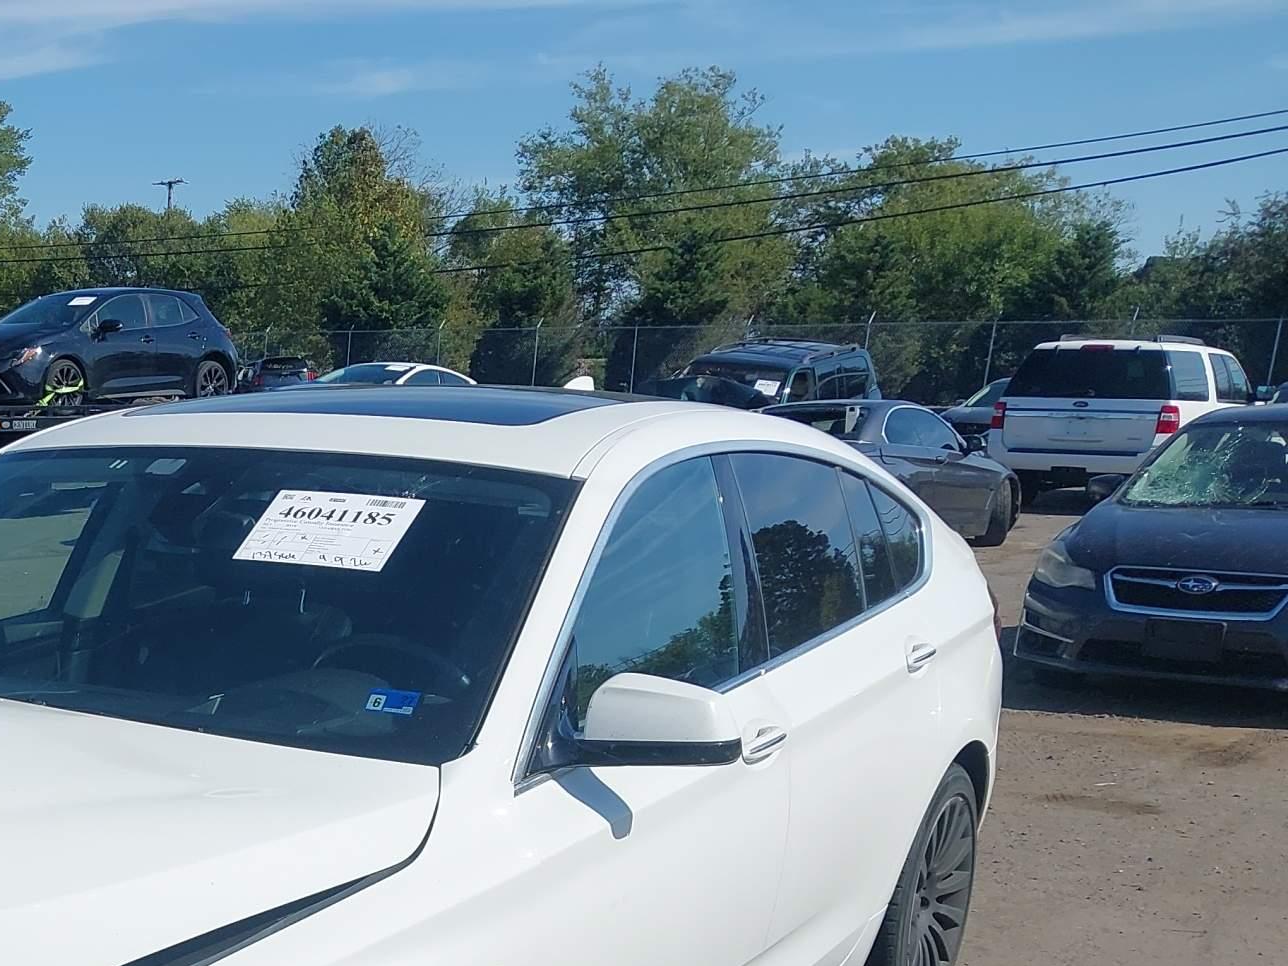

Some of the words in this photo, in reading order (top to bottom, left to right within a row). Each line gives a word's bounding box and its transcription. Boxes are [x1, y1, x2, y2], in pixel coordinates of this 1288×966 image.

[13, 420, 37, 430] CENTURY
[278, 505, 397, 527] 46041185
[372, 697, 382, 708] 6
